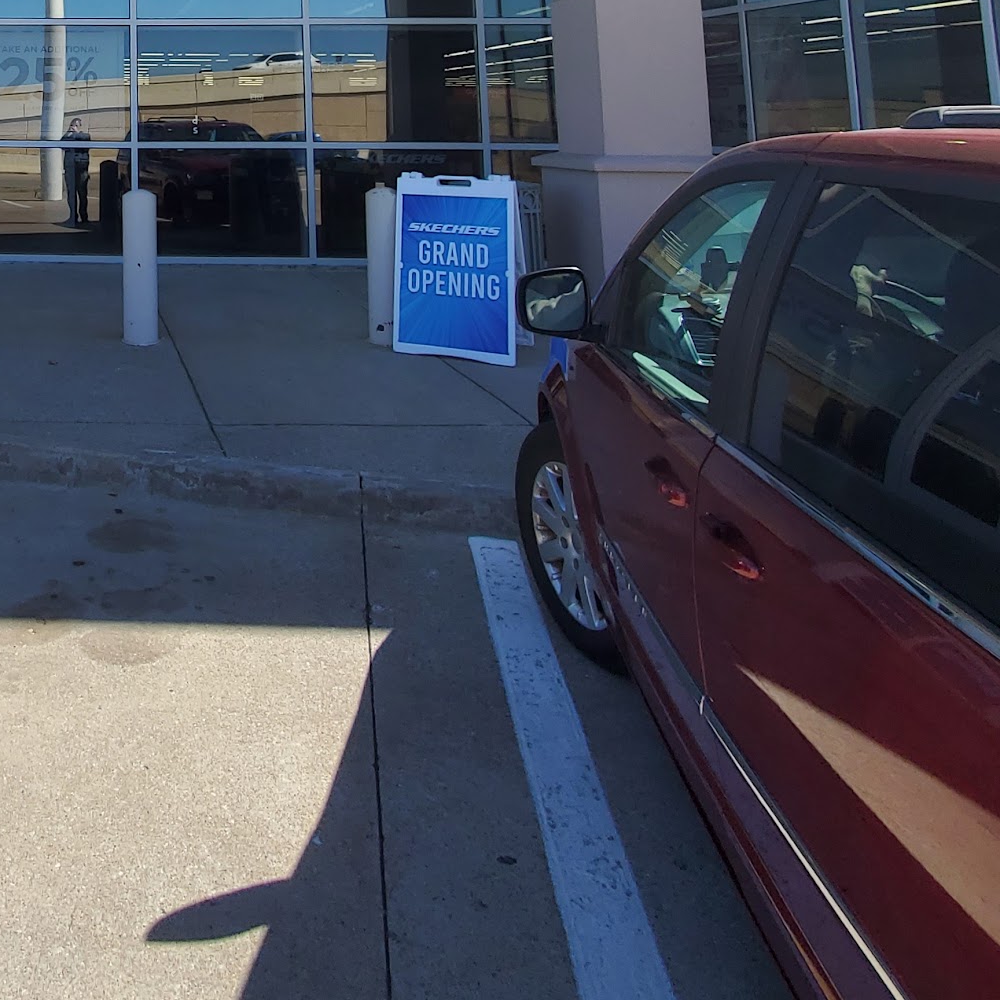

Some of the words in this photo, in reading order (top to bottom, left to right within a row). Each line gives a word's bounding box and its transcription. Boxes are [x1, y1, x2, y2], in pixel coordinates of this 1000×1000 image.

[24, 45, 38, 53] AN
[67, 87, 96, 97] OFF
[407, 222, 501, 237] SKECHERS
[418, 239, 489, 268] GRAND
[407, 268, 500, 300] OPENING
